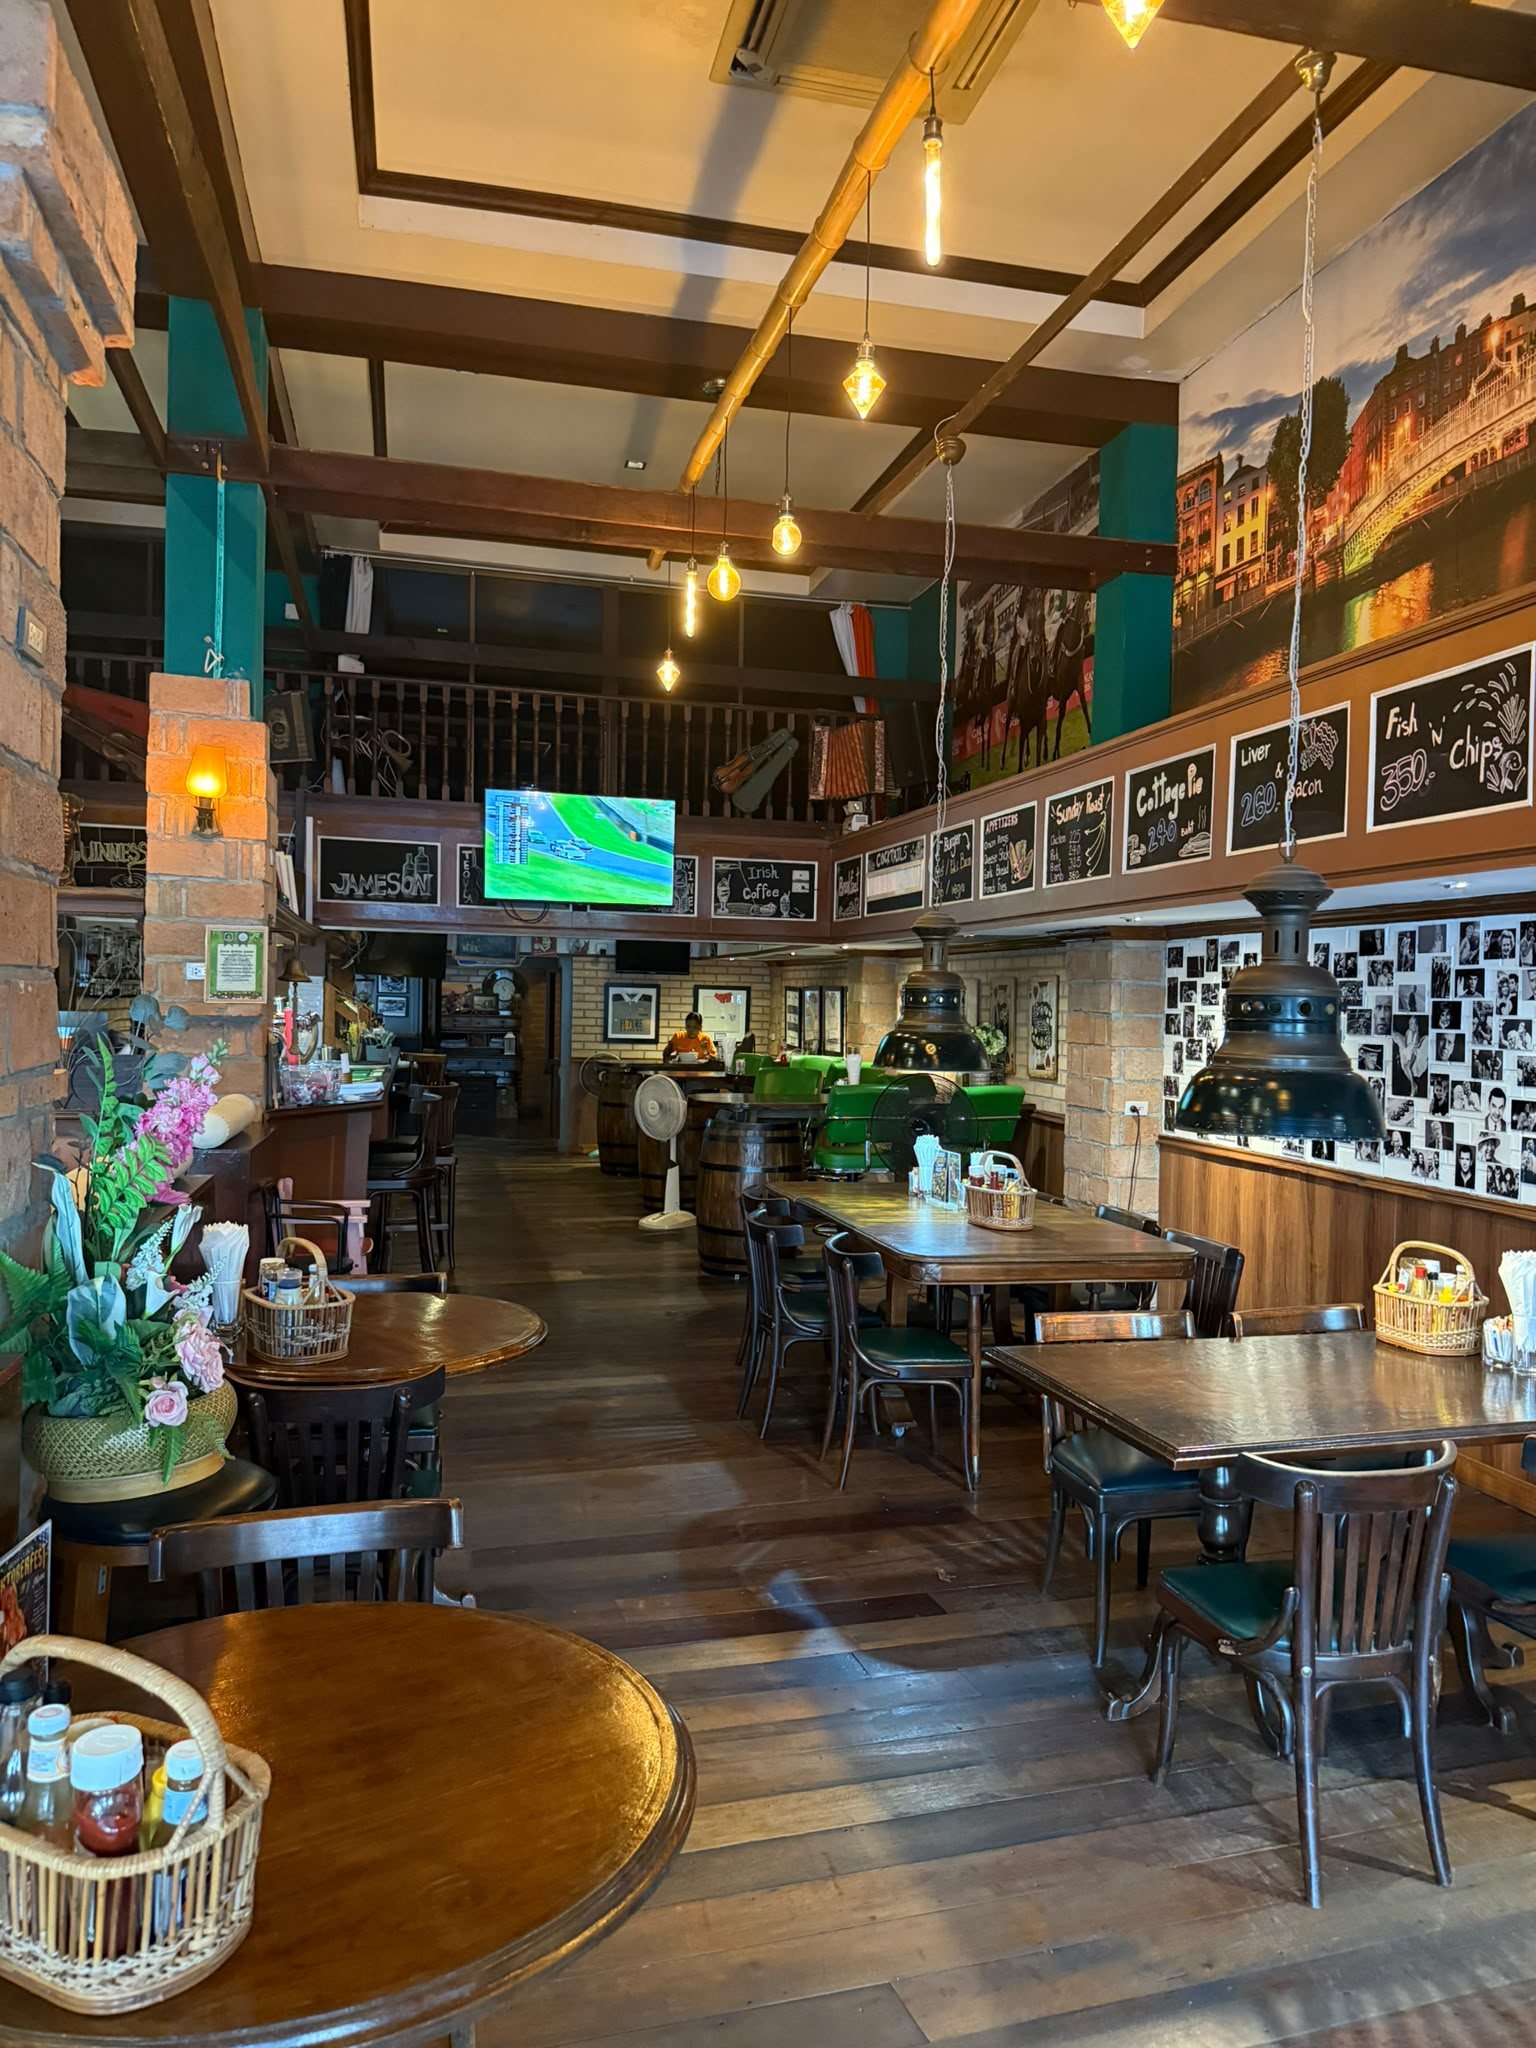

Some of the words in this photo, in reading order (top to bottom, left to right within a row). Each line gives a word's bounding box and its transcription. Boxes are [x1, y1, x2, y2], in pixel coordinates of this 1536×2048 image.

[1385, 702, 1418, 739] Fish
[1450, 724, 1503, 783] Chips
[1241, 743, 1271, 766] Liver
[1275, 762, 1284, 779] &
[1136, 771, 1186, 820] Cottage
[1187, 763, 1204, 798] Pie
[1056, 795, 1084, 825] Sunday
[985, 813, 1019, 835] APPETIZERS
[1148, 818, 1177, 853] 240
[944, 834, 961, 858] Burger
[1068, 829, 1081, 845] 225
[876, 846, 908, 868] COCKTAILS
[1068, 844, 1081, 857] 240
[329, 872, 434, 896] JAMESON
[747, 864, 780, 880] Irish
[743, 883, 780, 900] Coffee
